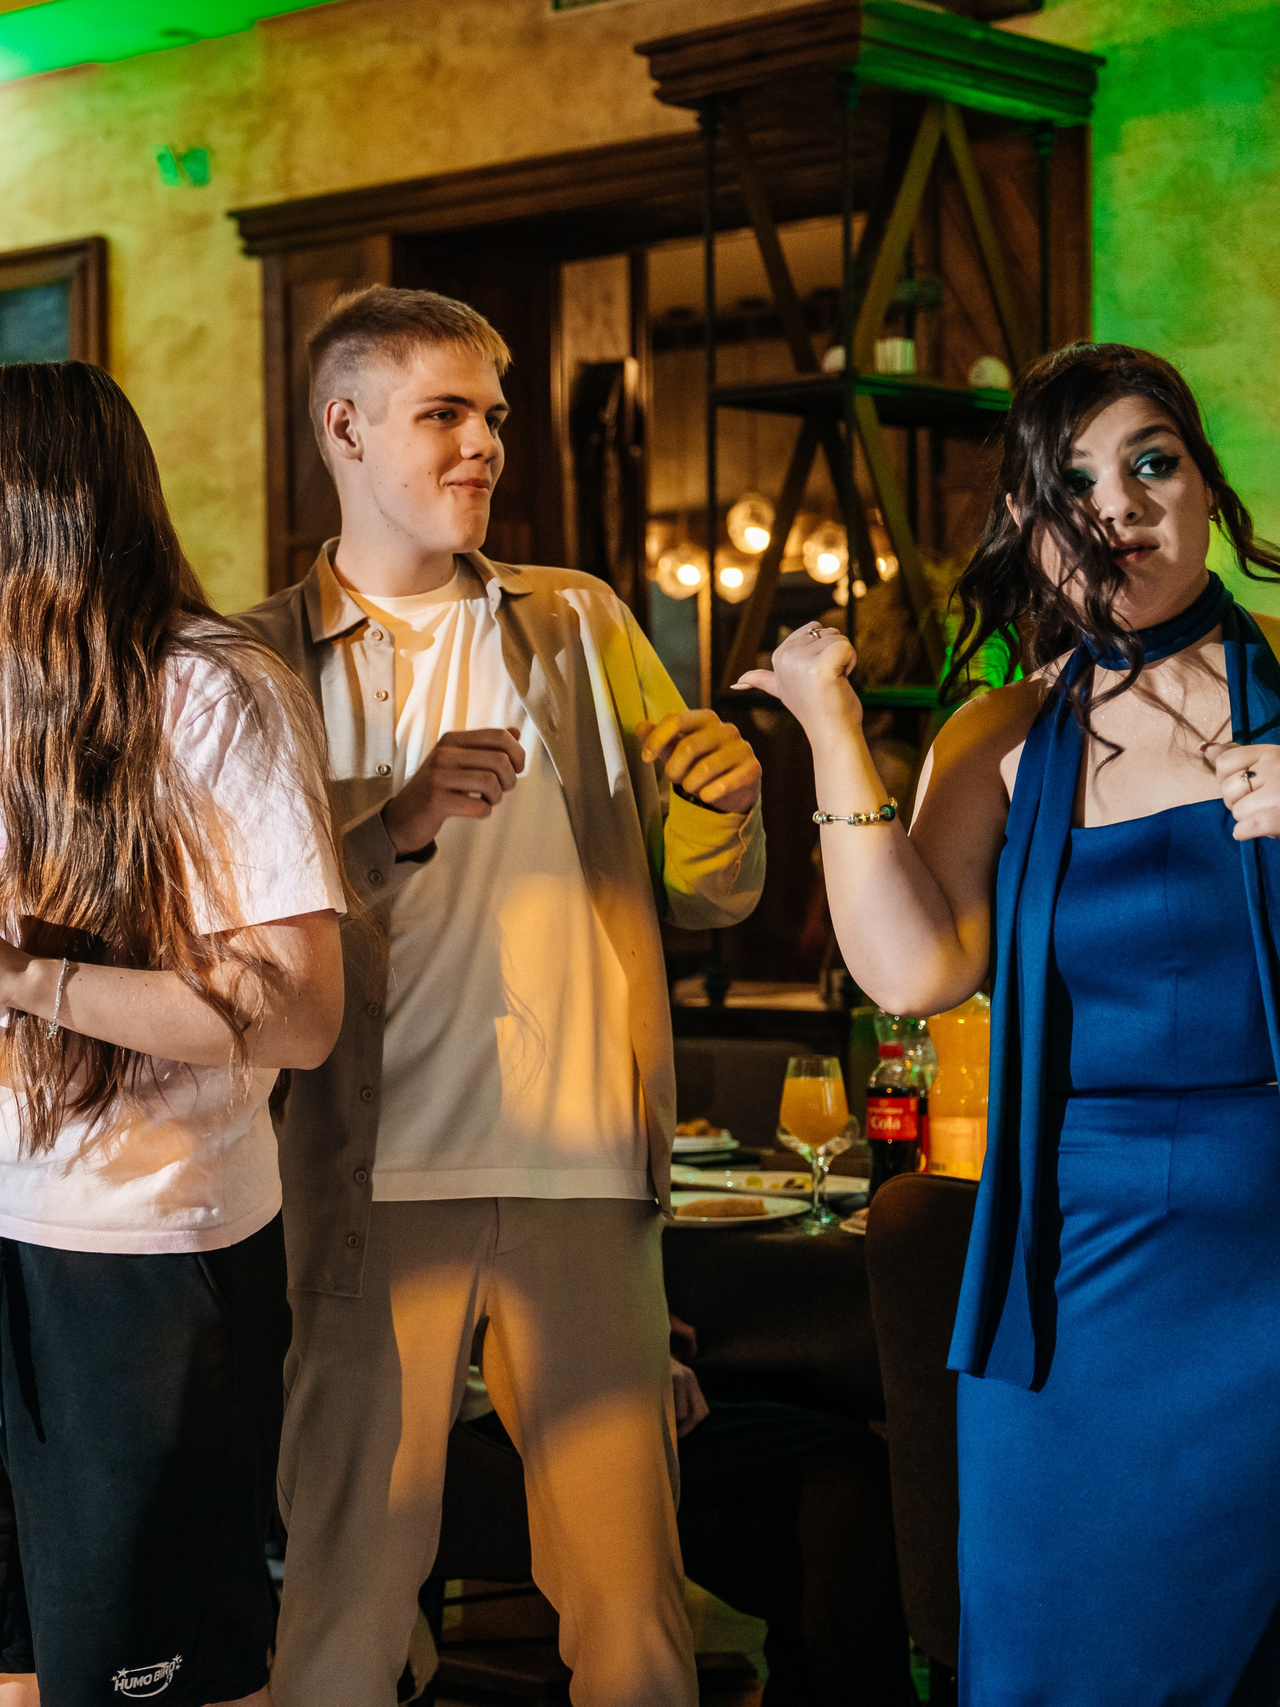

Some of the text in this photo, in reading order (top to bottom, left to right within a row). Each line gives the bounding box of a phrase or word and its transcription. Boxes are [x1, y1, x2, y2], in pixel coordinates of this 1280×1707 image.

[870, 1115, 901, 1131] Cola
[114, 1660, 176, 1692] HUMO BIRD
